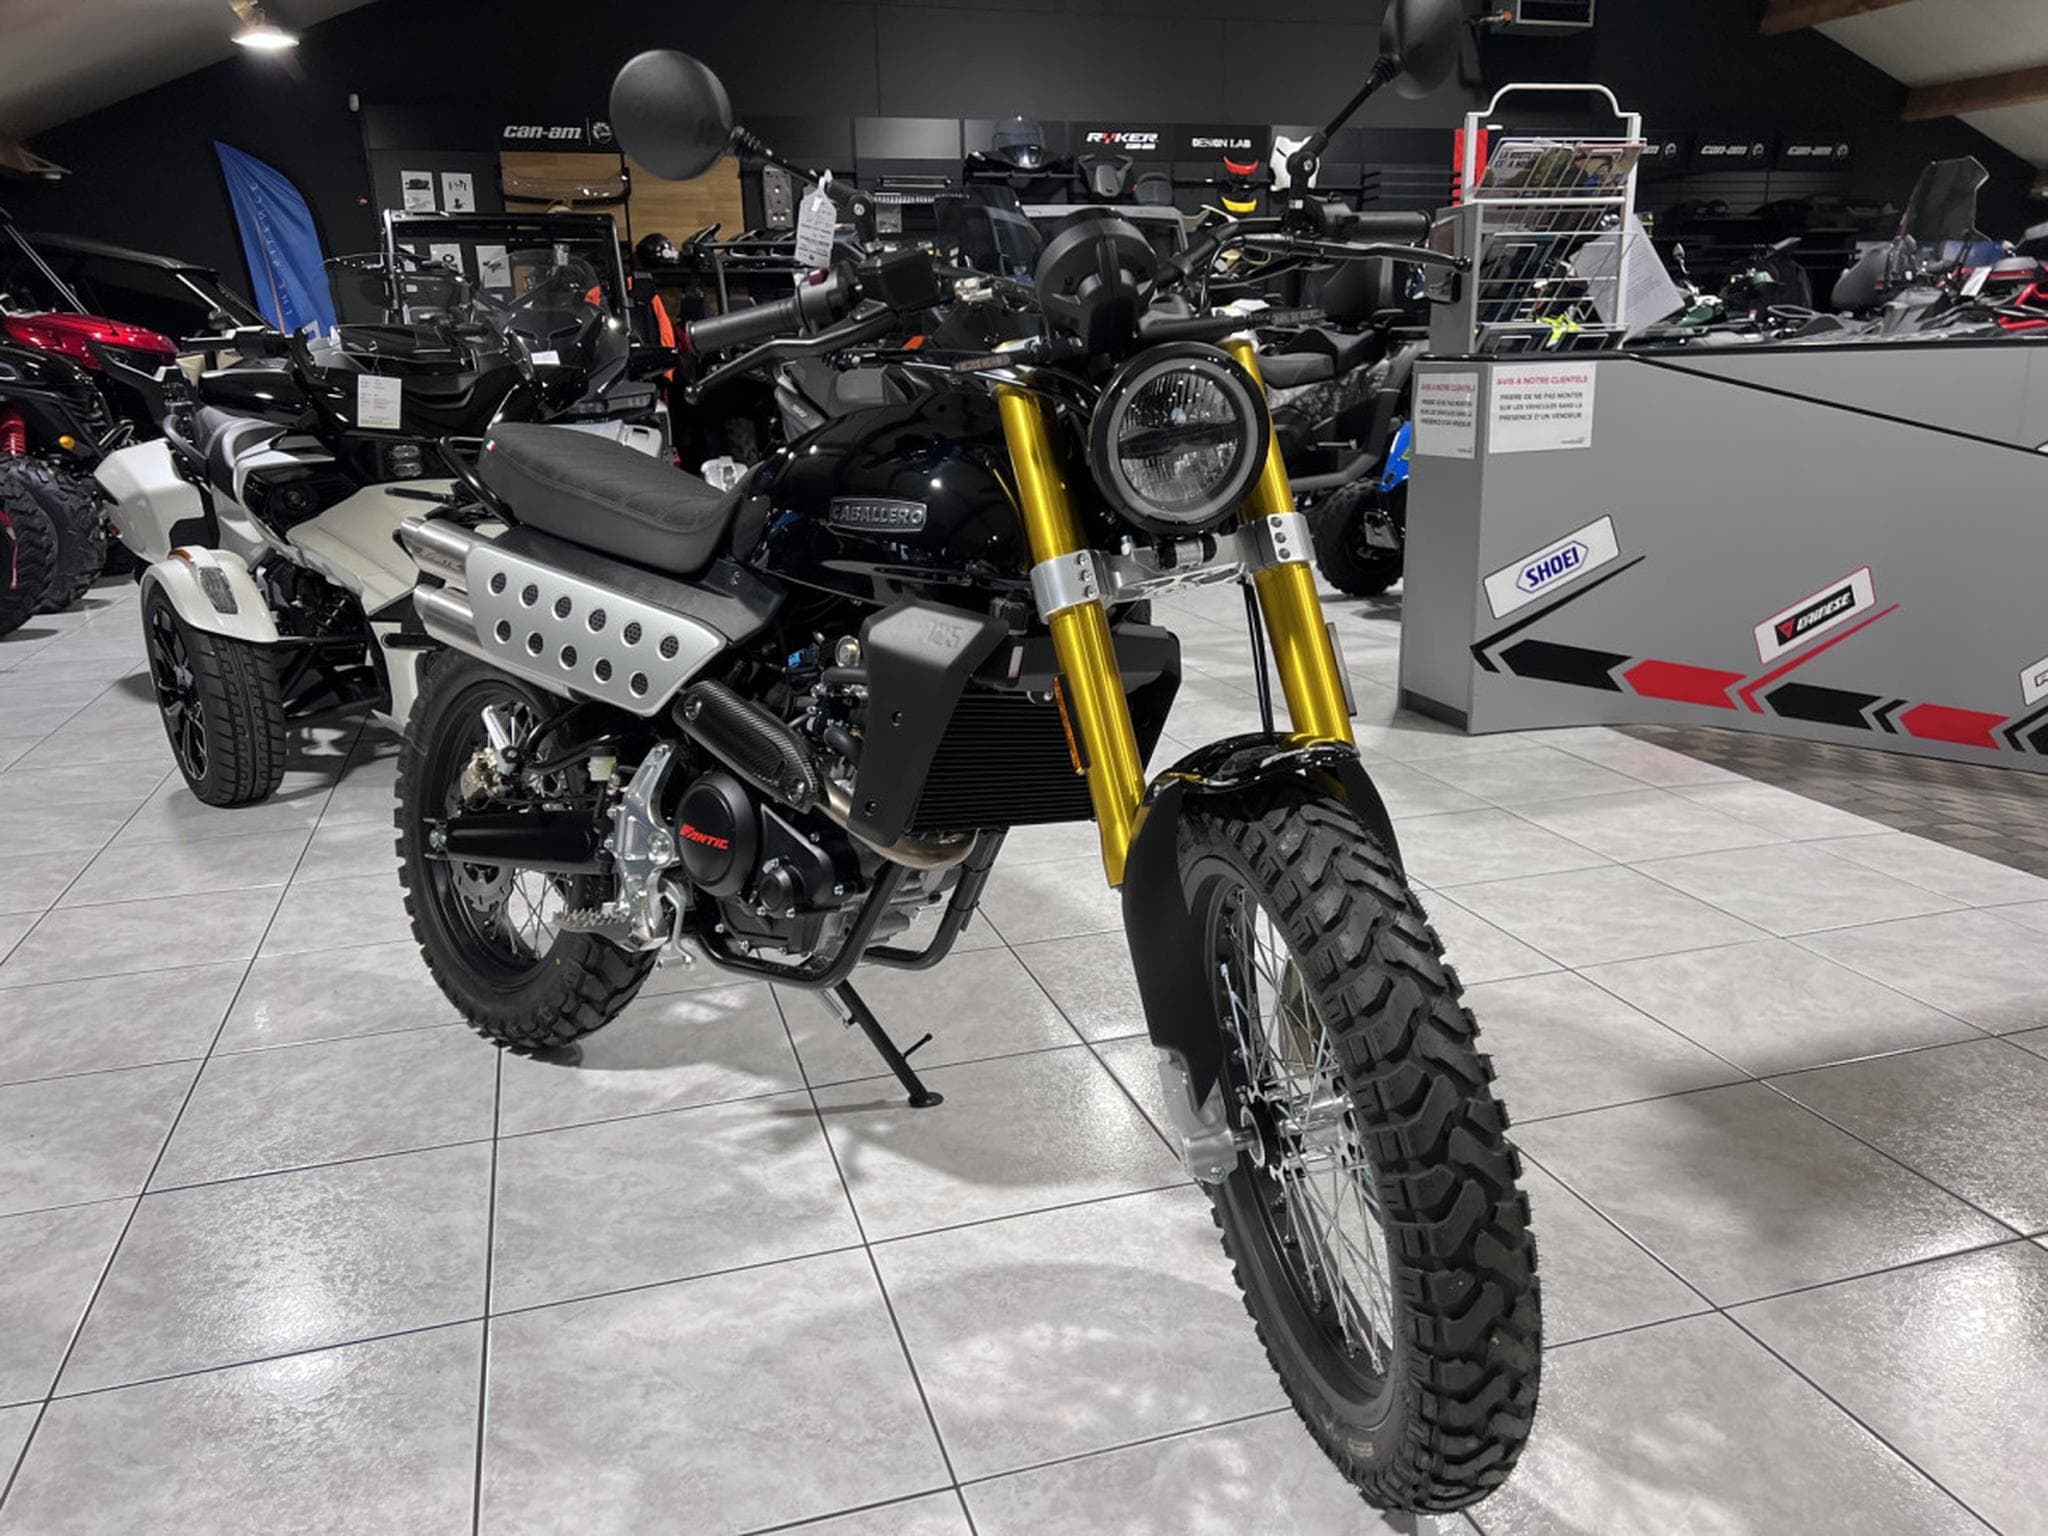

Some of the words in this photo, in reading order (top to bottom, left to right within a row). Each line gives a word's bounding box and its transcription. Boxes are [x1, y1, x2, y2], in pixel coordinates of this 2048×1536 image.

[503, 126, 582, 139] can-am
[1086, 132, 1158, 144] RYKER
[832, 504, 923, 524] CABALLERO
[1525, 546, 1580, 588] SHOEI
[1797, 592, 1852, 632] DAINESE
[680, 823, 729, 850] FANTIC
